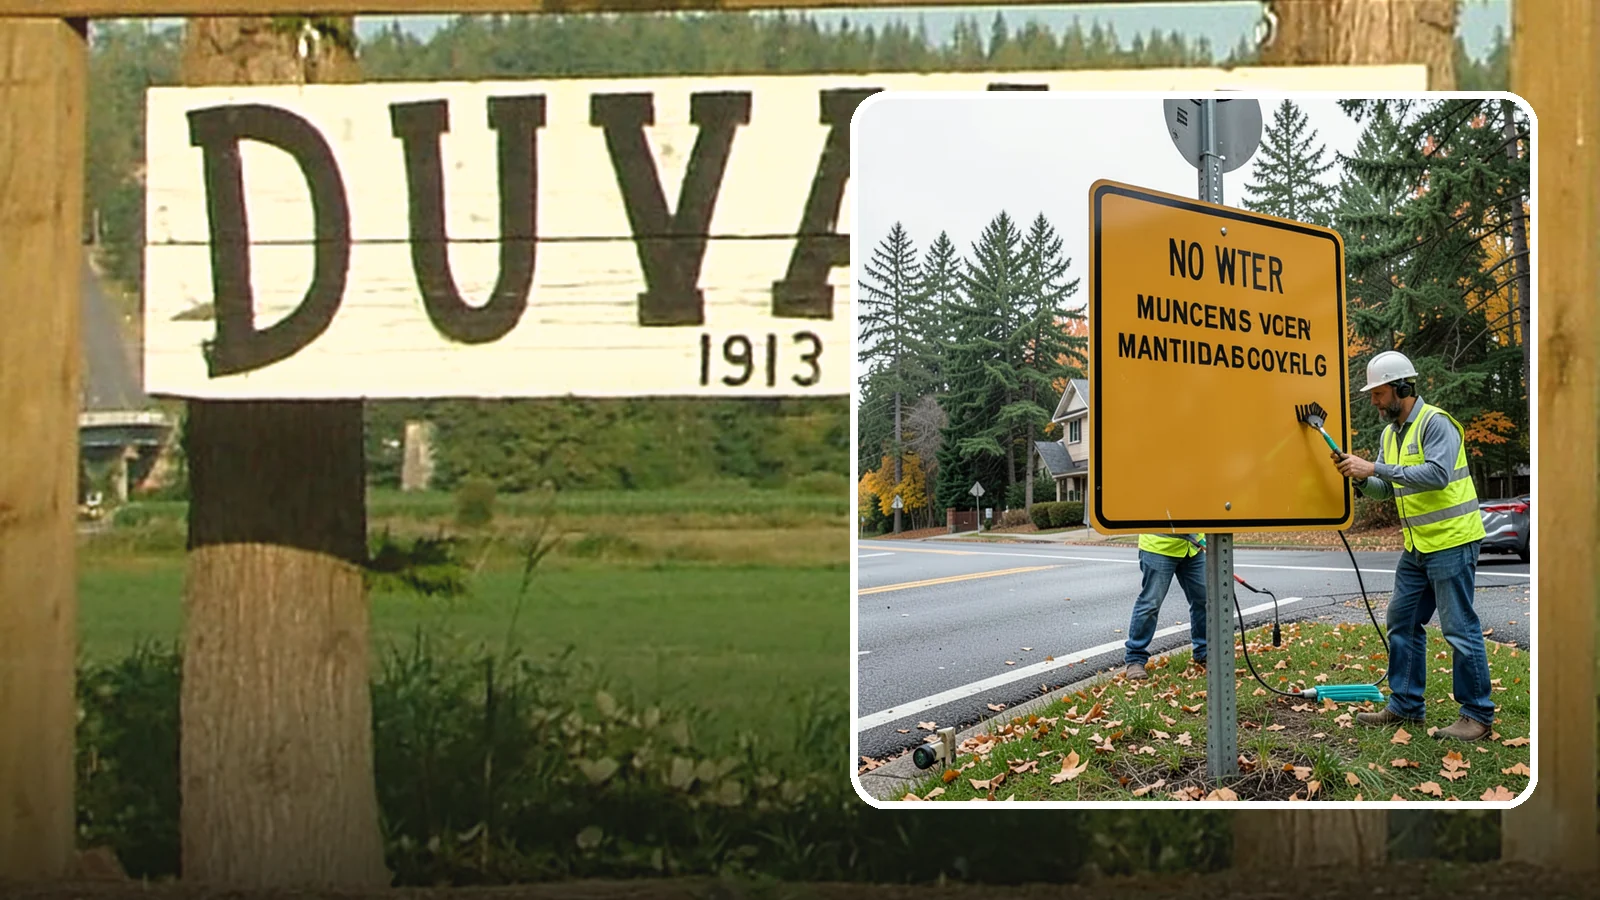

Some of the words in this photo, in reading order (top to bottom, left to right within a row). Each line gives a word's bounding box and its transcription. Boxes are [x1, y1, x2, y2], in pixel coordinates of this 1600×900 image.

[1169, 237, 1204, 281] NO
[1214, 245, 1284, 295] WTER
[1137, 293, 1252, 333] MUNCENS
[700, 331, 823, 387] 1913
